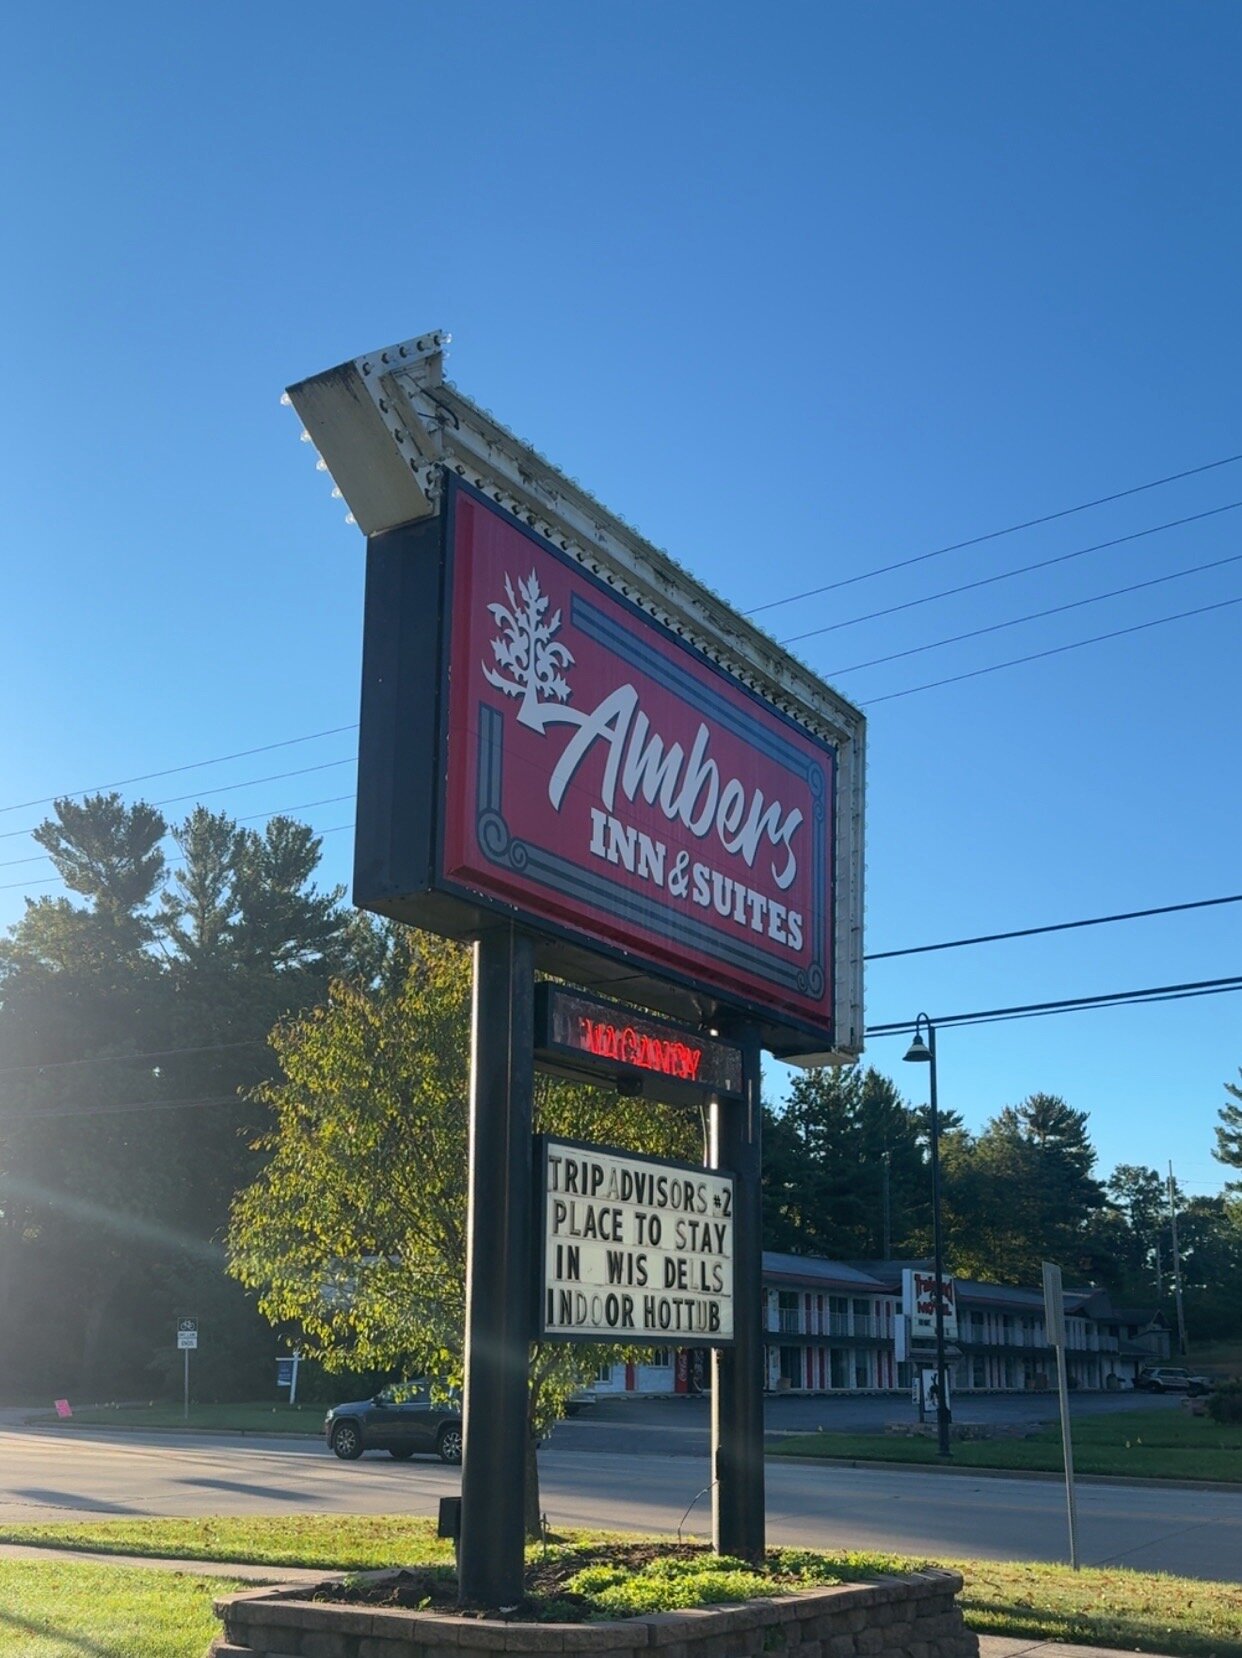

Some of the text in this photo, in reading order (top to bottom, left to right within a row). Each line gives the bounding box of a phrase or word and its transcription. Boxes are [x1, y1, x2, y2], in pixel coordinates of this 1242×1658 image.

[548, 684, 804, 890] Ambers
[590, 807, 804, 952] INN & SUITES
[553, 1199, 727, 1255] PLACE TO STAY
[713, 1187, 731, 1218] #2
[556, 1244, 724, 1293] IN WIS DELLS
[547, 1288, 635, 1327] INDOOR
